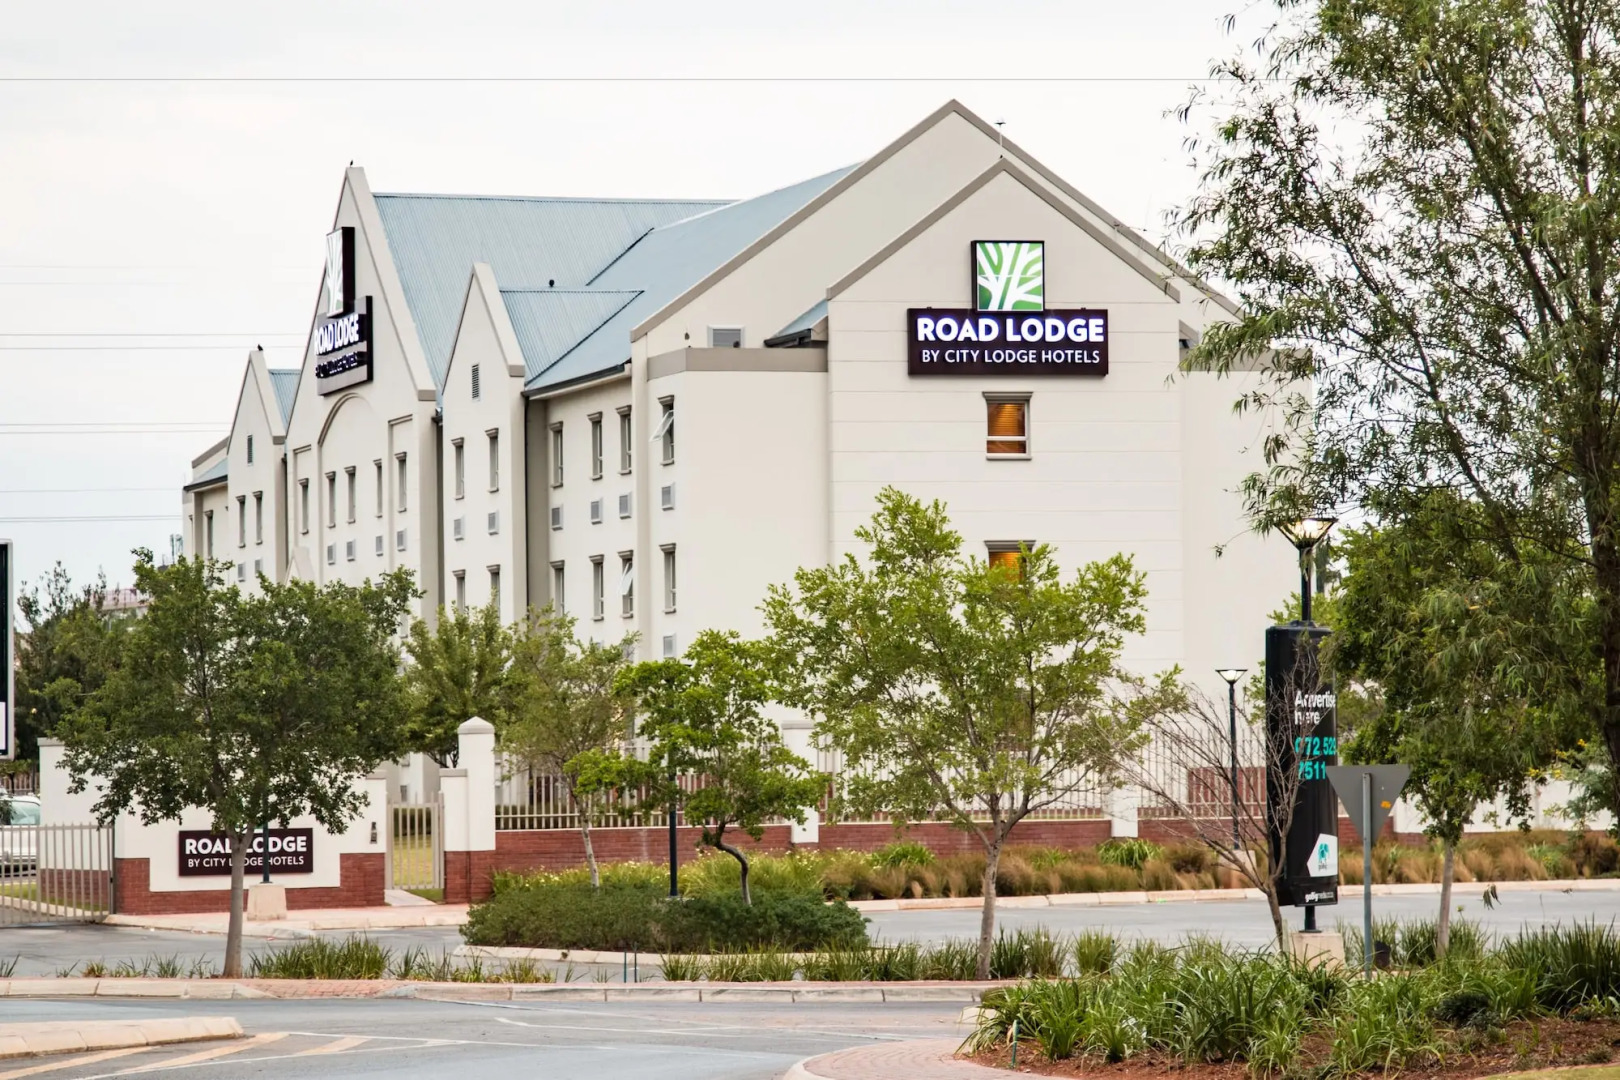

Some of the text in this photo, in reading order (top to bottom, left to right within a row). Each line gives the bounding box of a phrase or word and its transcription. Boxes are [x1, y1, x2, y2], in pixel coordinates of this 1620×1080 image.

[314, 313, 359, 355] ROAD LODGE
[917, 317, 1105, 342] ROAD LODGE
[922, 350, 1100, 363] BY CITY LODGE HOTELS
[188, 859, 200, 868] BY
[202, 858, 227, 867] CITY
[228, 857, 263, 867] LDGE
